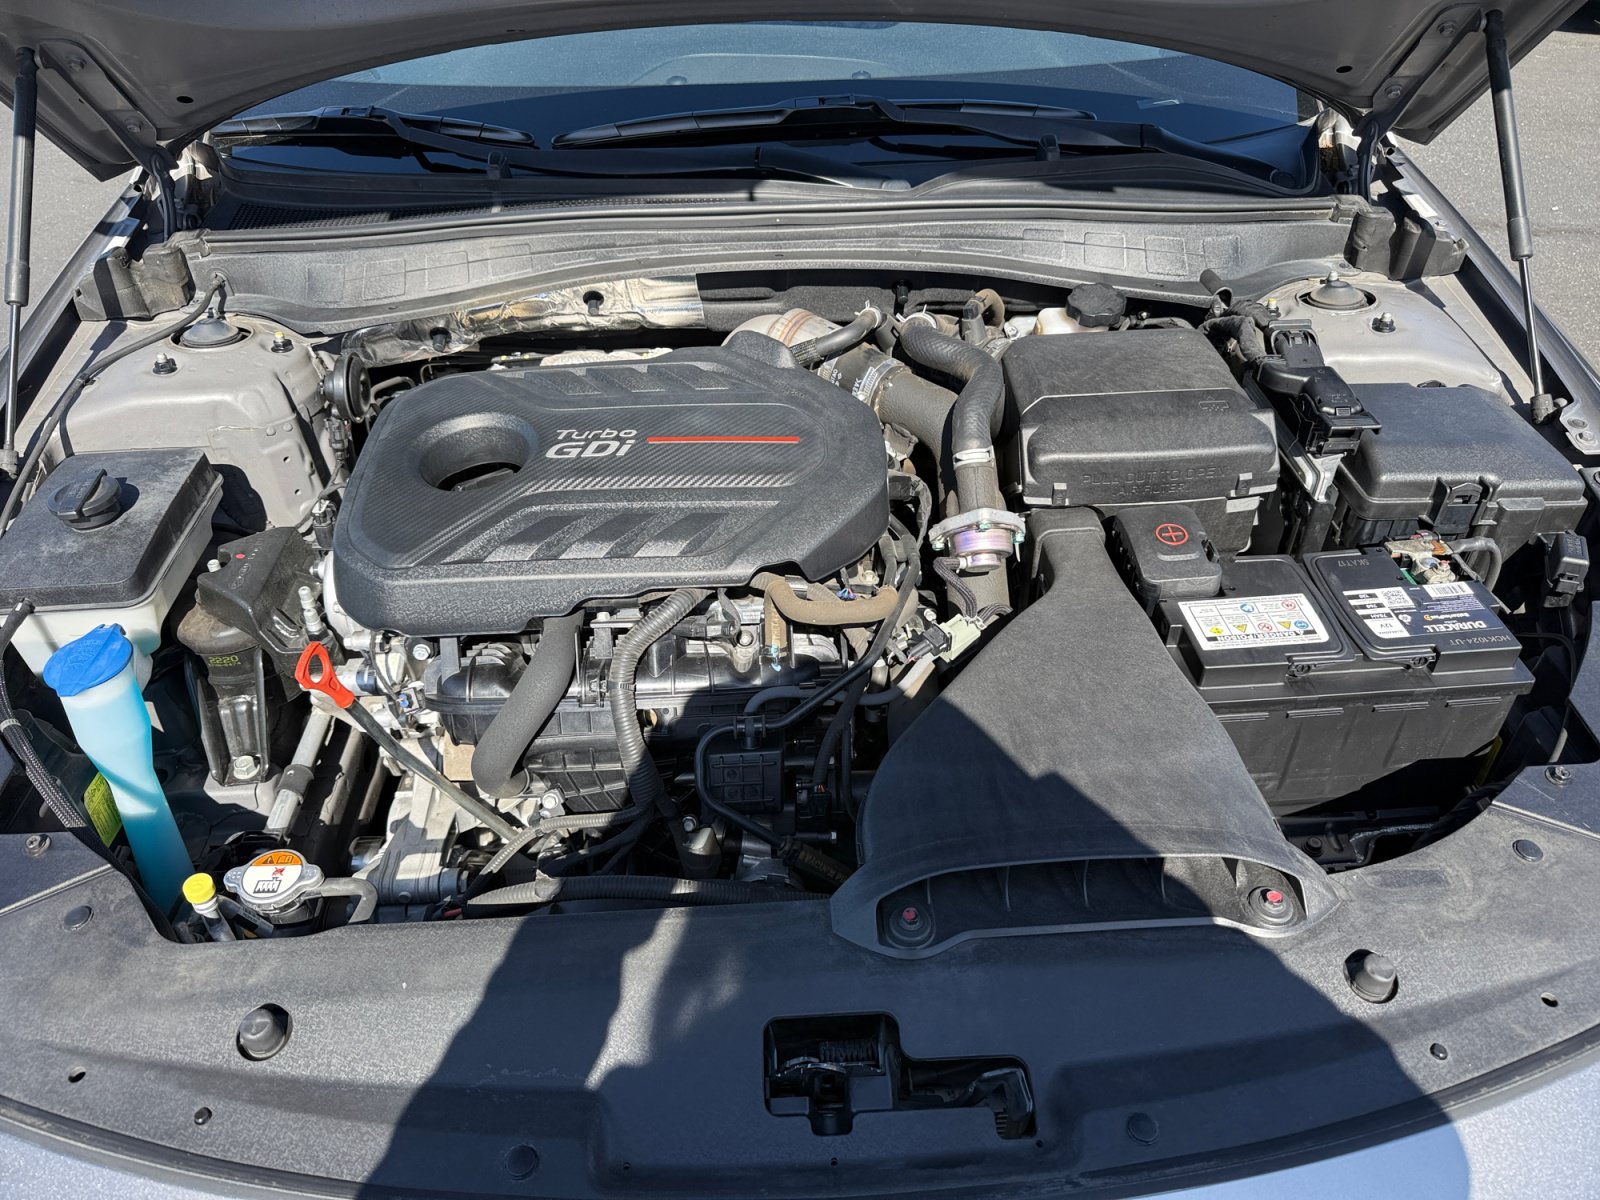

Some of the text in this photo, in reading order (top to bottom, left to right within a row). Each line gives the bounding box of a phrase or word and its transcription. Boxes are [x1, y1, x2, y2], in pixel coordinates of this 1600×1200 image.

[556, 428, 638, 440] Turbo
[545, 440, 636, 459] GDi
[1082, 466, 1226, 486] PULL OUT TO OPEN
[1423, 620, 1487, 633] DURACELL
[1217, 630, 1294, 642] DANGER/POISON
[1449, 634, 1511, 646] HCK1024-UT
